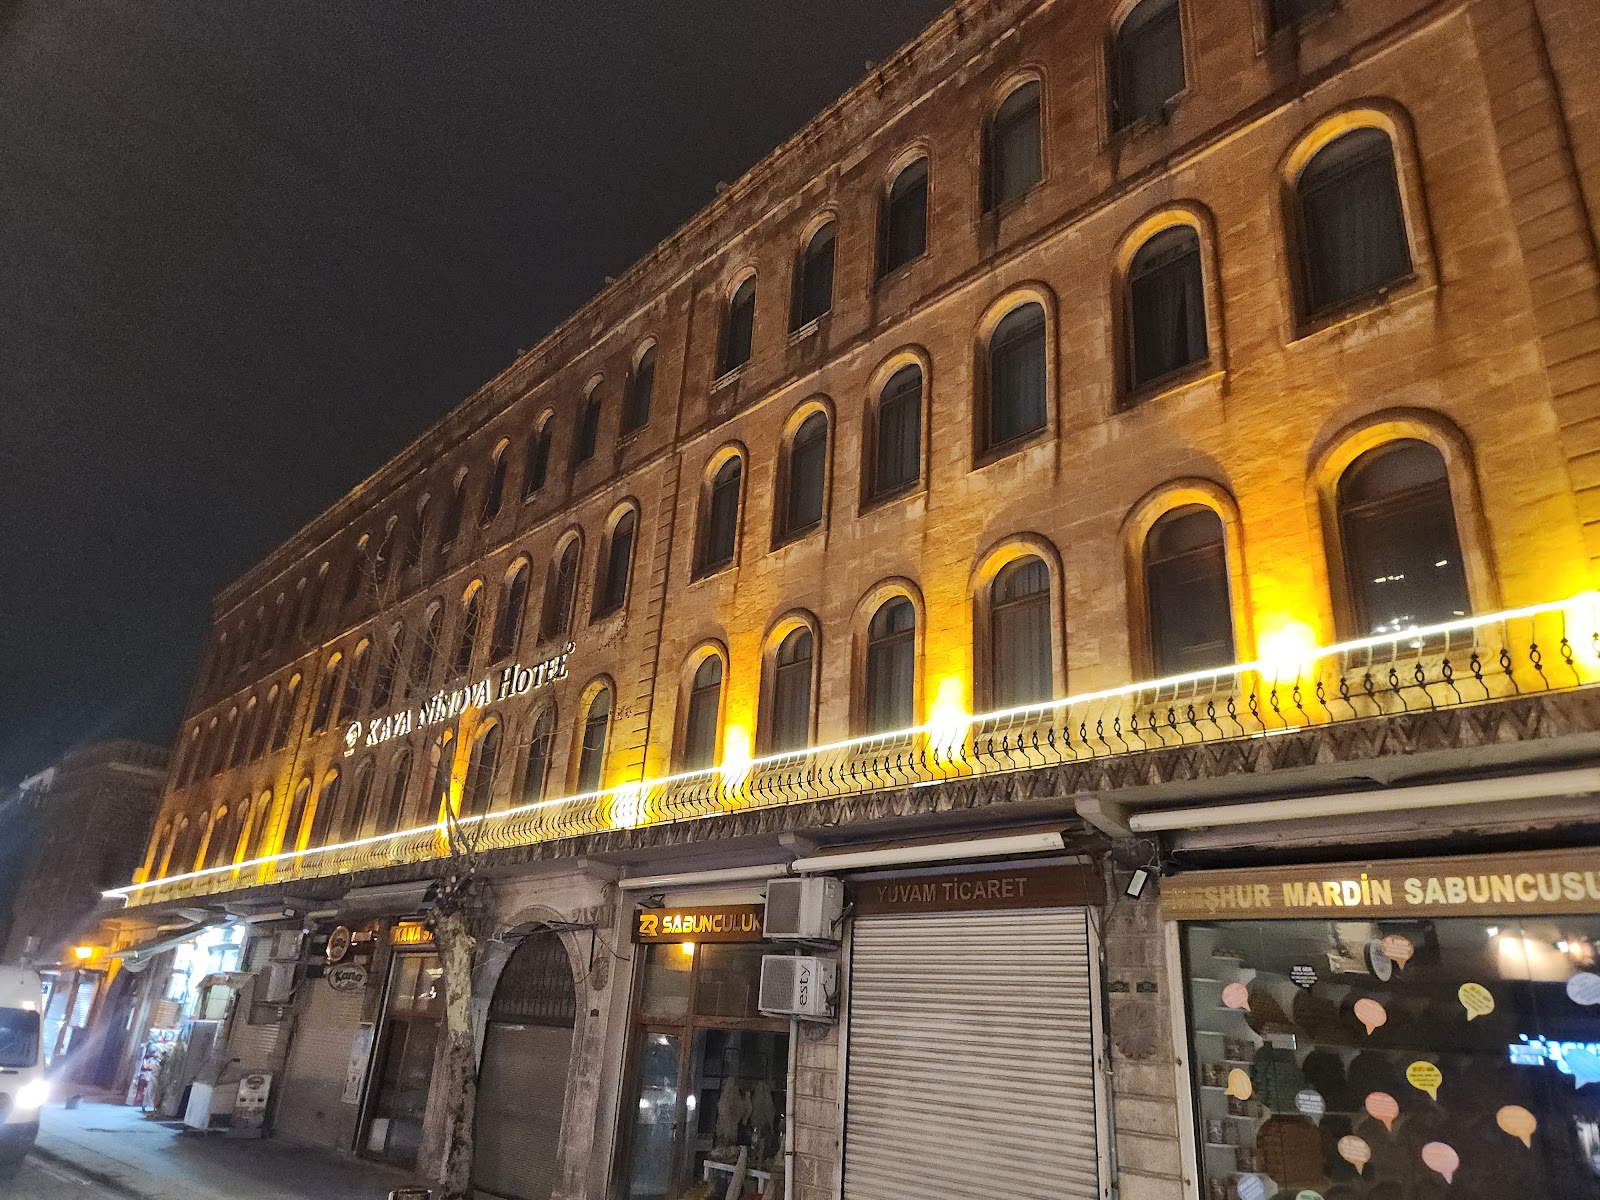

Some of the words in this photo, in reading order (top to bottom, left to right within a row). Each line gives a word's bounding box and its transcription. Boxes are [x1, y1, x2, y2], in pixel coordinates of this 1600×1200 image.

[365, 709, 412, 747] KAYA
[942, 877, 1028, 900] TİCARET
[1172, 883, 1271, 914] EŞHUR
[1282, 873, 1393, 907] MARDİN
[1404, 871, 1600, 905] SABUNCUSU
[394, 926, 421, 942] KANA
[662, 913, 763, 934] SABUNCULUK
[799, 964, 811, 1007] esty
